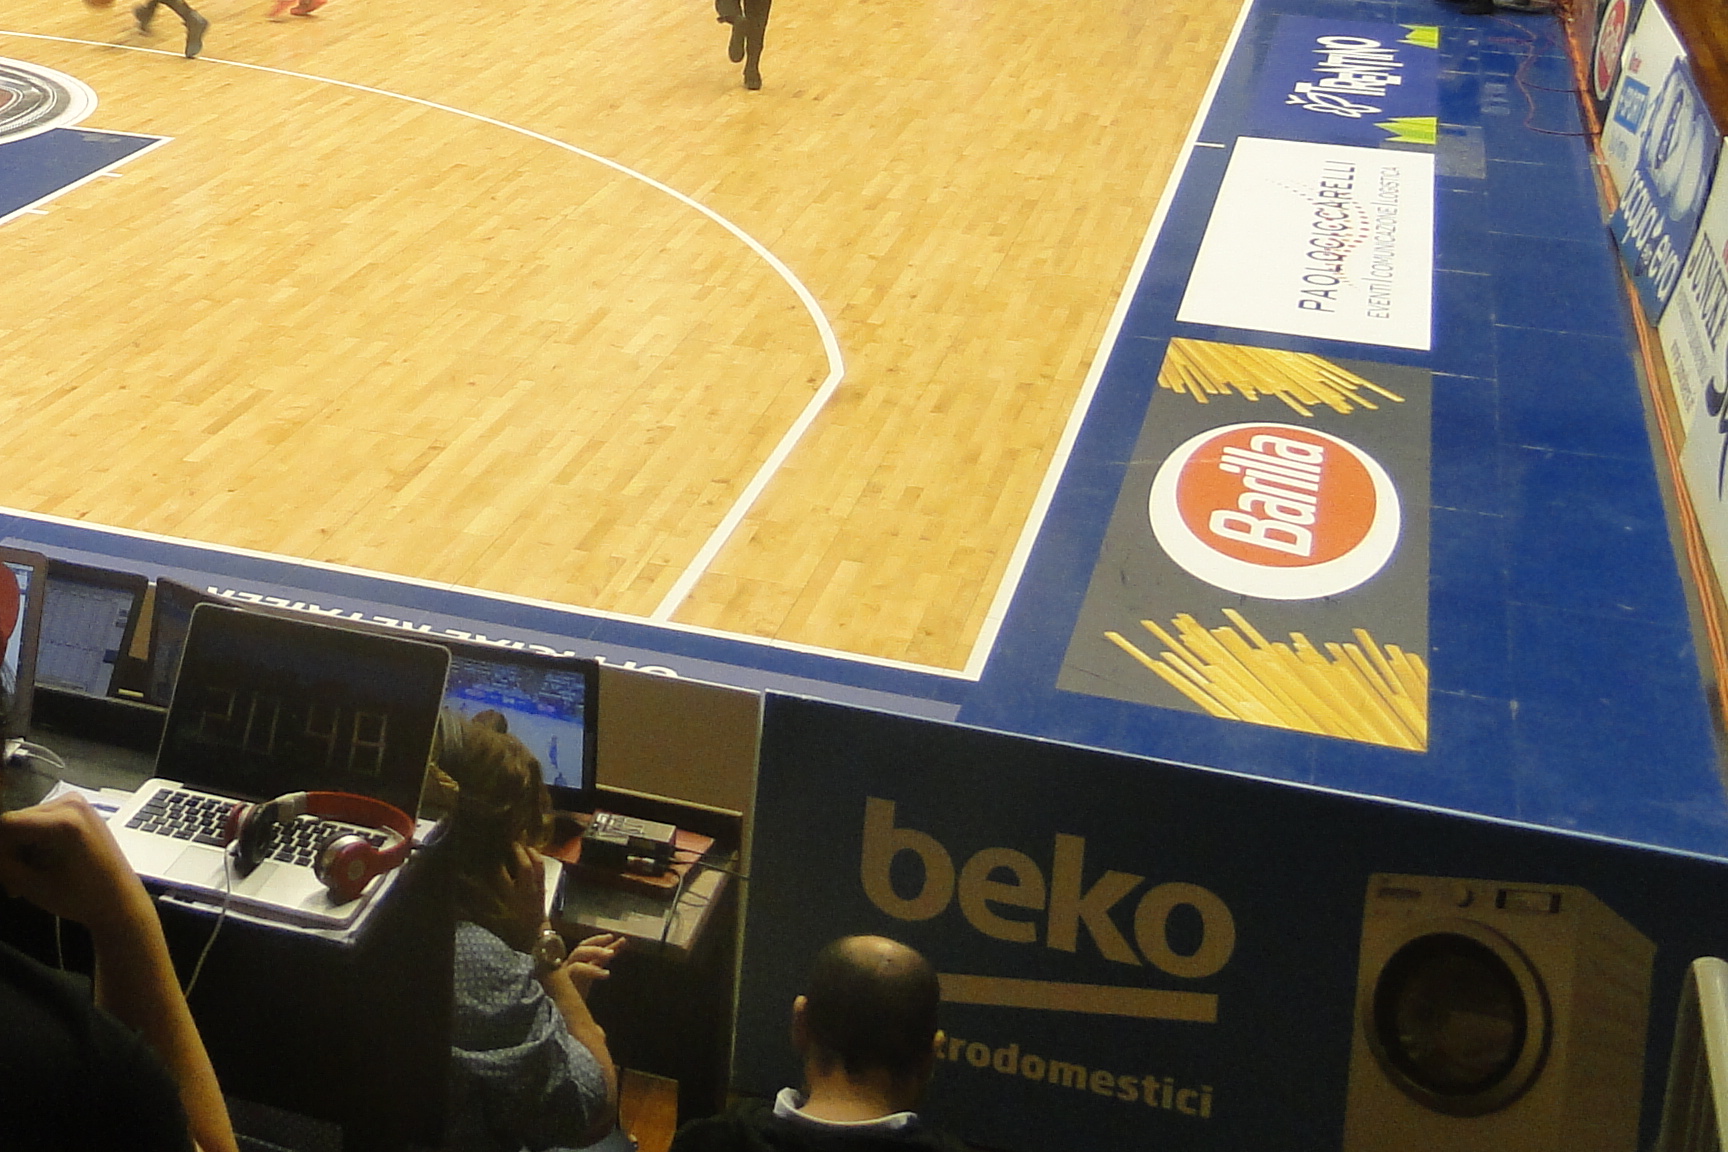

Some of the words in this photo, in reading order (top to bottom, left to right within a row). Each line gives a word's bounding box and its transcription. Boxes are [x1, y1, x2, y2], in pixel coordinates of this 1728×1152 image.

[1208, 433, 1325, 558] Barilla
[860, 795, 1236, 979] beko
[936, 1034, 1215, 1119] trodomestici
